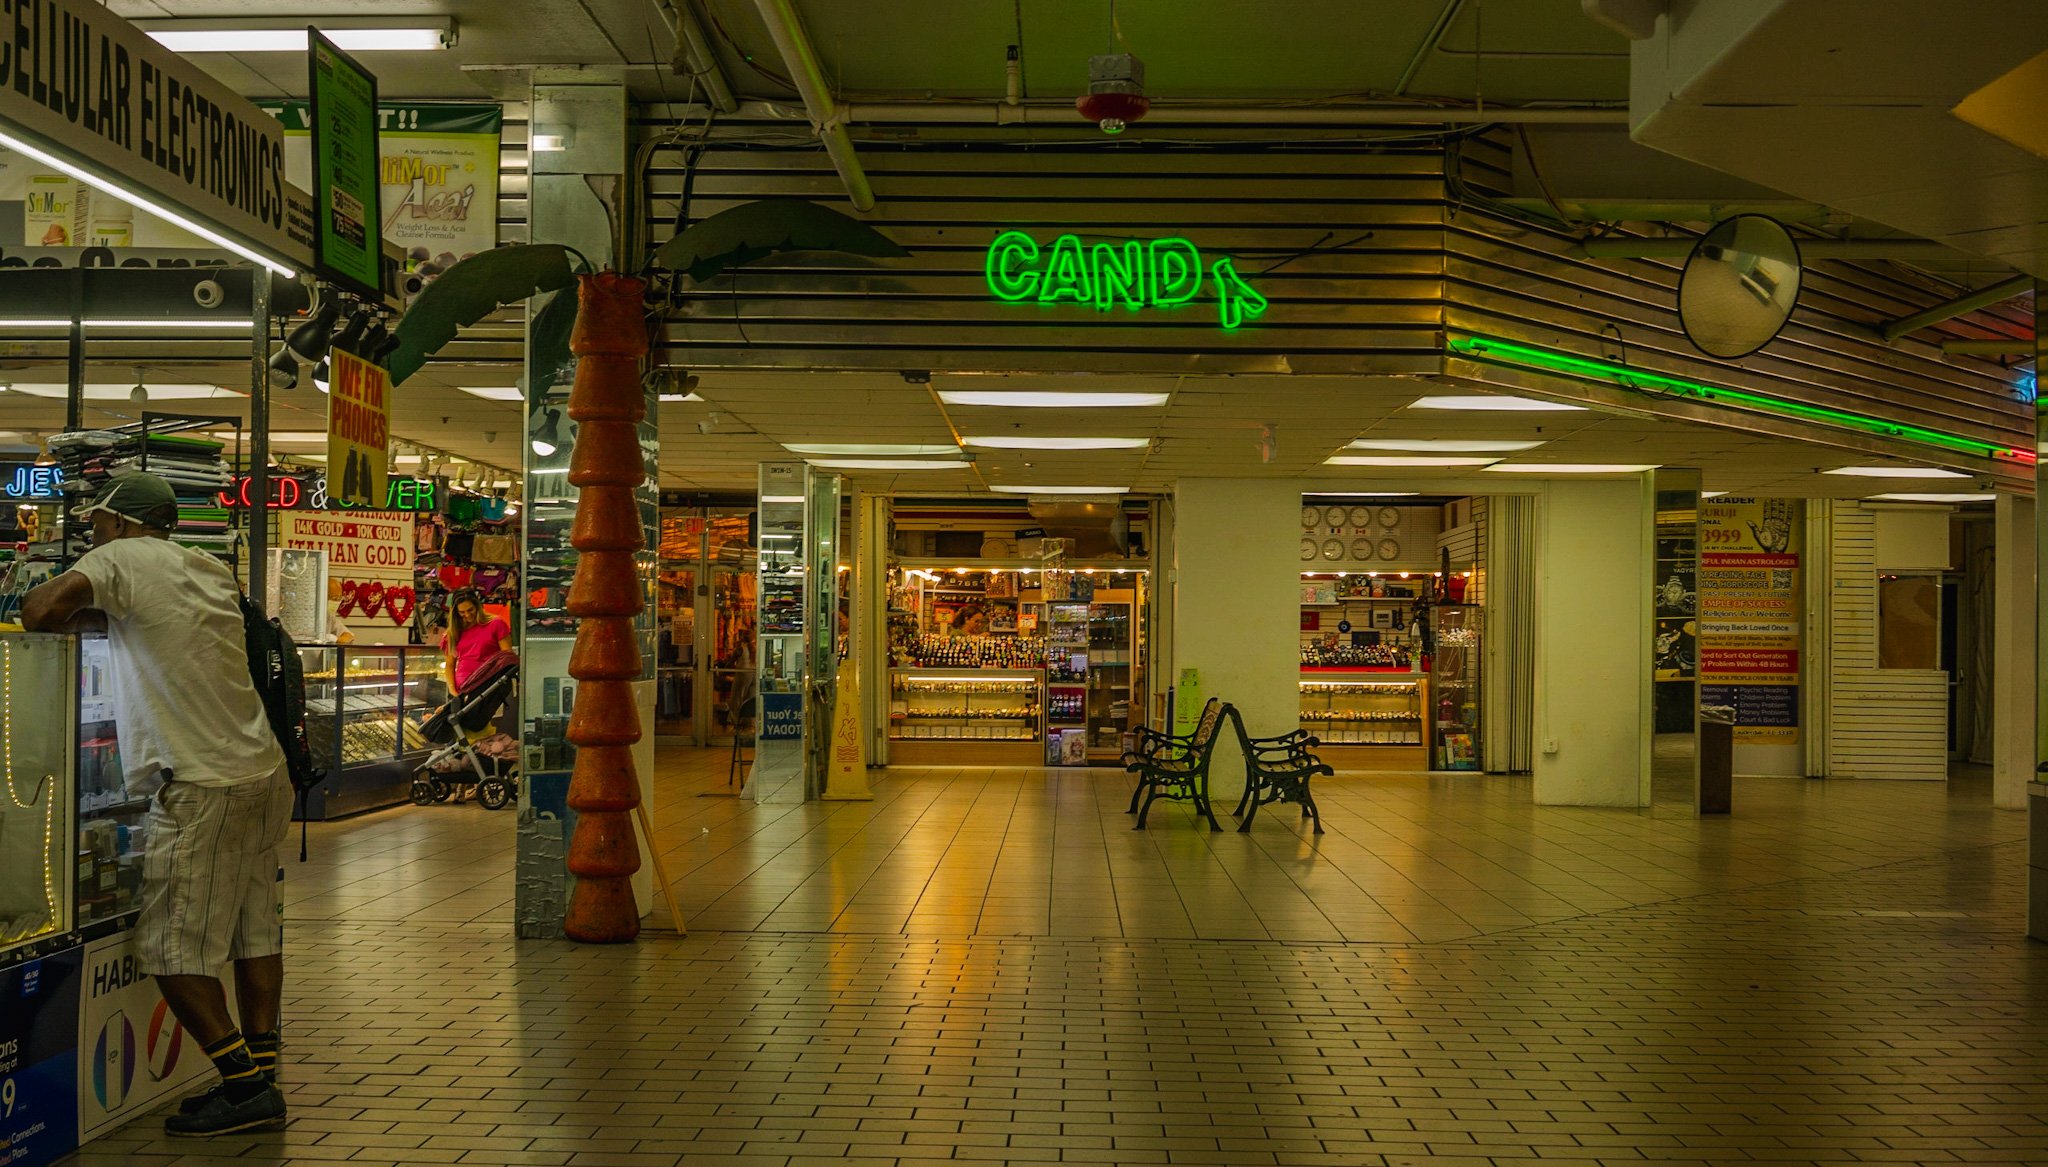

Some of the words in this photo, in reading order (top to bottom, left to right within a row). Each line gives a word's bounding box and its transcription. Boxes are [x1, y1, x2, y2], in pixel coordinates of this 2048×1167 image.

[140, 58, 283, 231] ELECTRONICS
[386, 177, 475, 222] Acai
[396, 223, 423, 233] Weight
[424, 224, 440, 232] Loss
[450, 224, 466, 232] Acai
[396, 230, 424, 239] Cleanse
[425, 231, 456, 239] Formula
[337, 353, 362, 400] WE
[364, 365, 383, 409] FIX
[332, 396, 386, 451] PHONES
[311, 479, 330, 510] &
[295, 519, 314, 534] 14K
[316, 521, 343, 536] GOLD
[356, 524, 373, 538] 10K
[375, 526, 401, 541] GOLD
[685, 518, 705, 532] EXIT
[1702, 529, 1741, 543] 3959
[366, 544, 407, 566] GOLD
[1747, 571, 1767, 579] FACE
[1720, 581, 1769, 589] HOROSCOPE
[1733, 600, 1746, 608] OF
[1747, 600, 1786, 608] SUCCESS
[1703, 610, 1738, 618] Religions
[1702, 624, 1730, 632] Bringing
